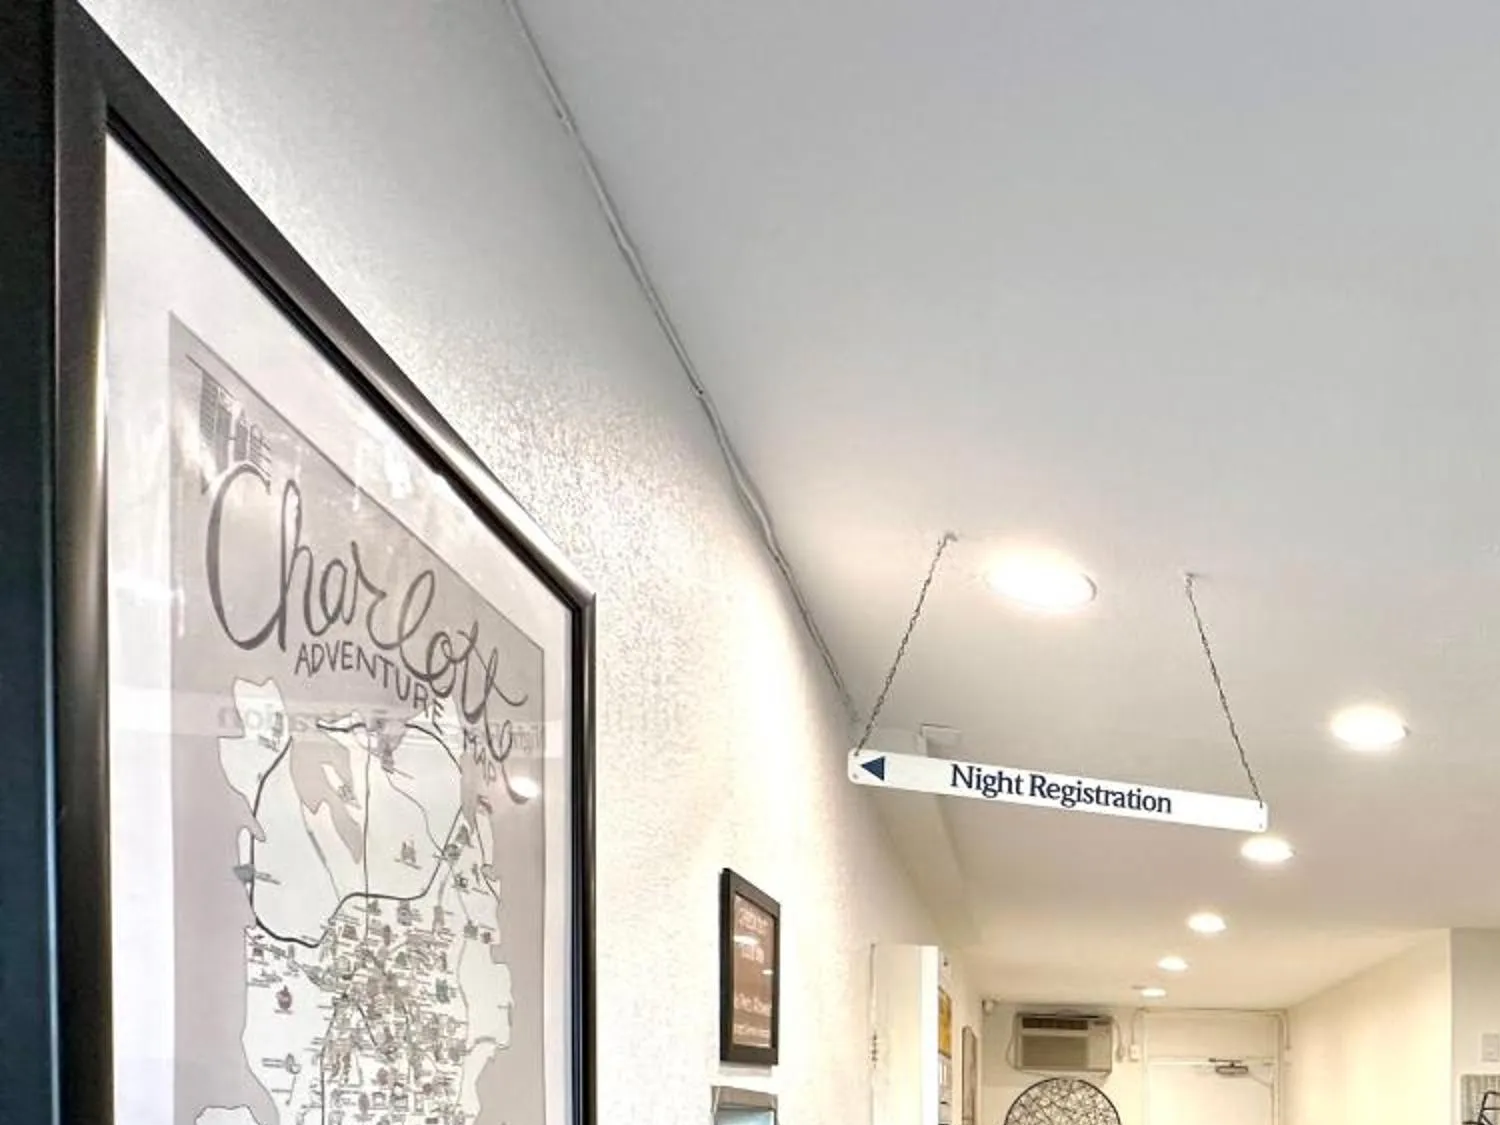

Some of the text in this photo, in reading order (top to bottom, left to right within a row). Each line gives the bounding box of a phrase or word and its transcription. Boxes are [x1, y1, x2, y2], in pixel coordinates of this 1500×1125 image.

[205, 463, 529, 805] Charlotte
[294, 640, 444, 736] ADVENTURE
[950, 763, 1172, 814] Night Registration
